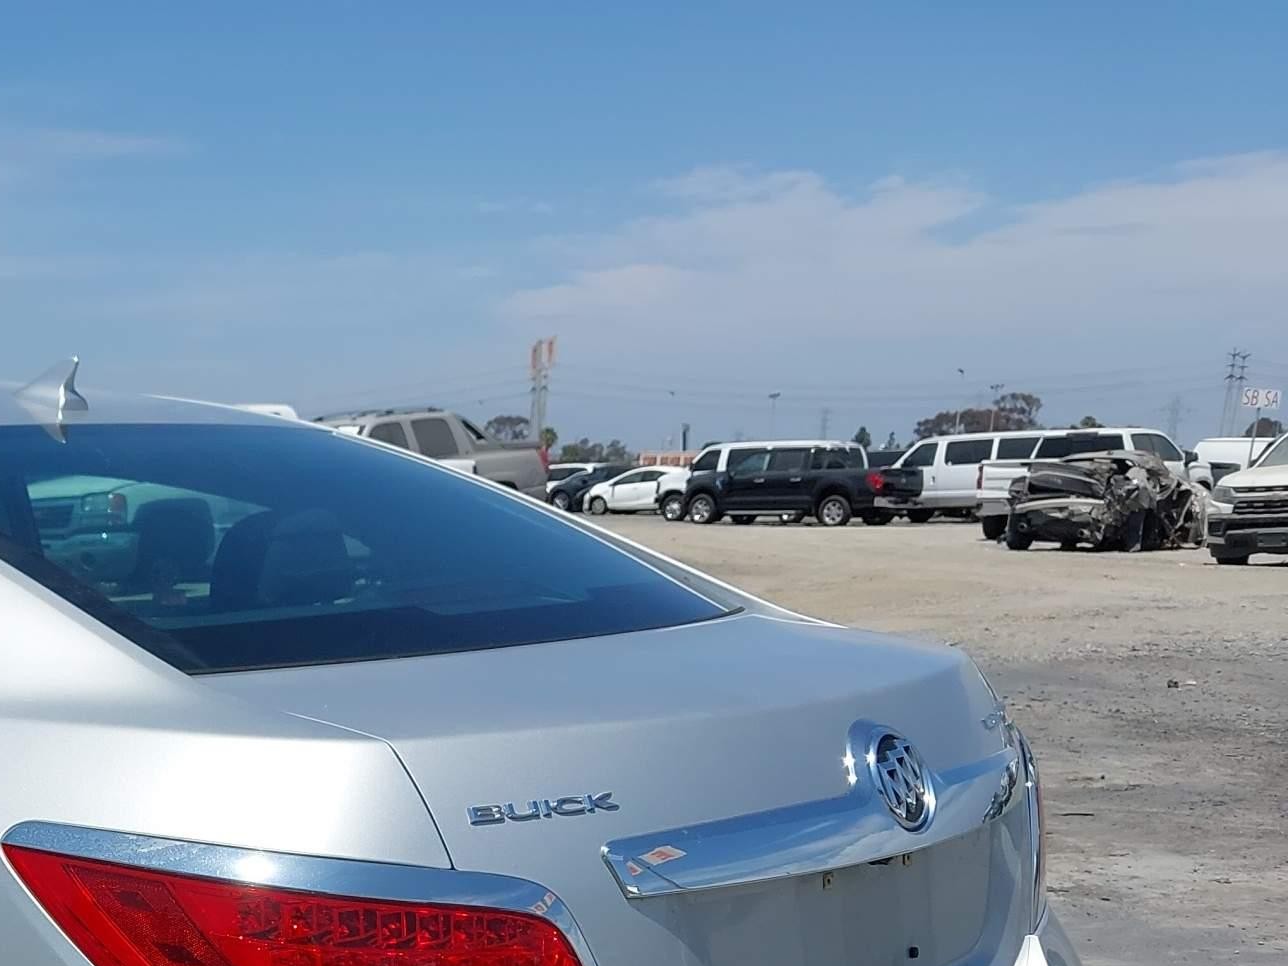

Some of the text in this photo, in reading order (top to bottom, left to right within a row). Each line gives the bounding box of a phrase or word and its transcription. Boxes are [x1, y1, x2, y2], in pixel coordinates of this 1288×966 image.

[1242, 388, 1279, 408] SB SA
[467, 792, 620, 826] BUICK
